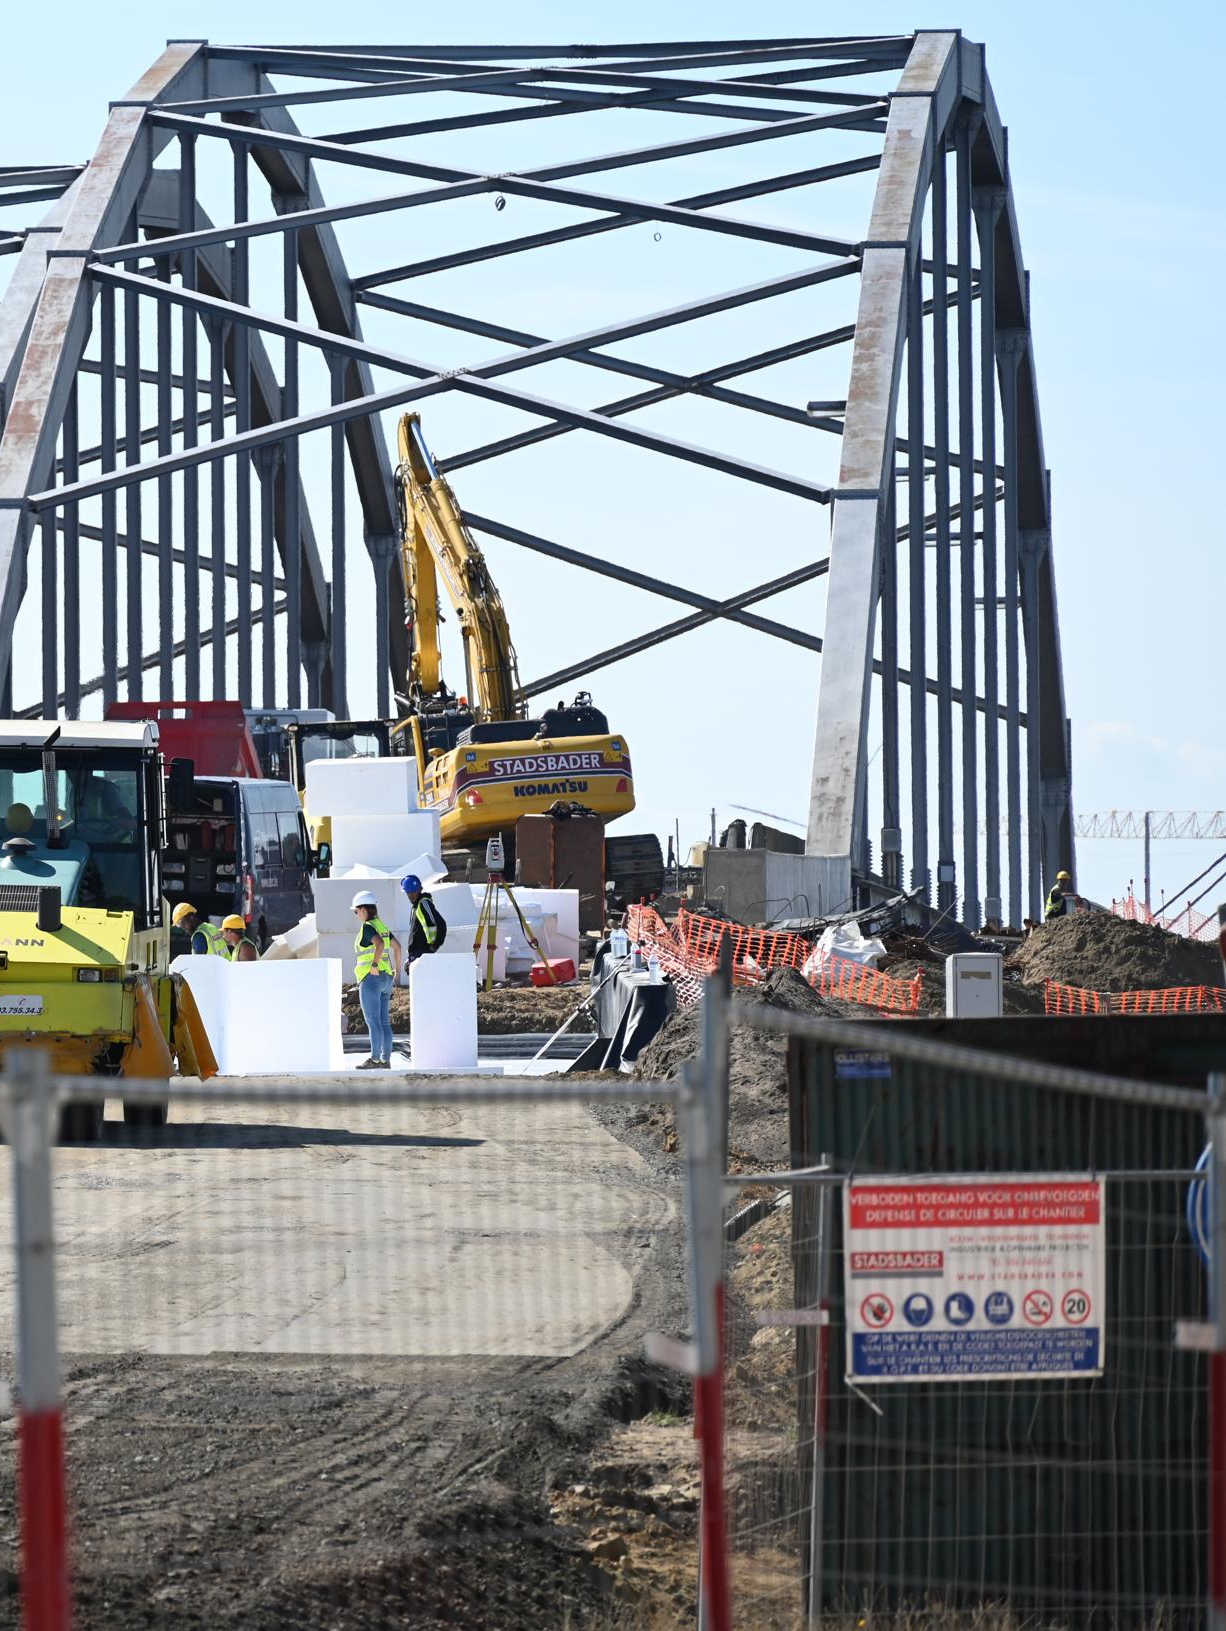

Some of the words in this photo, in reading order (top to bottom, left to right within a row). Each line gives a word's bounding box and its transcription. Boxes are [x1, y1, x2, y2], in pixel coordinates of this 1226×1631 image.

[494, 753, 601, 776] STADSBADER
[513, 779, 589, 797] KOMATSU
[851, 1192, 914, 1206] VERBODEN
[916, 1191, 975, 1205] TOEGANG
[977, 1190, 1011, 1204] VOOR
[866, 1208, 916, 1222] DEFENSE
[920, 1208, 935, 1221] DE
[938, 1207, 991, 1221] CIRCULER
[993, 1206, 1015, 1220] SUR
[1018, 1206, 1030, 1219] LE
[1031, 1204, 1086, 1219] CHANTIER
[854, 1252, 941, 1269] STADSBADER
[1066, 1298, 1086, 1314] 20
